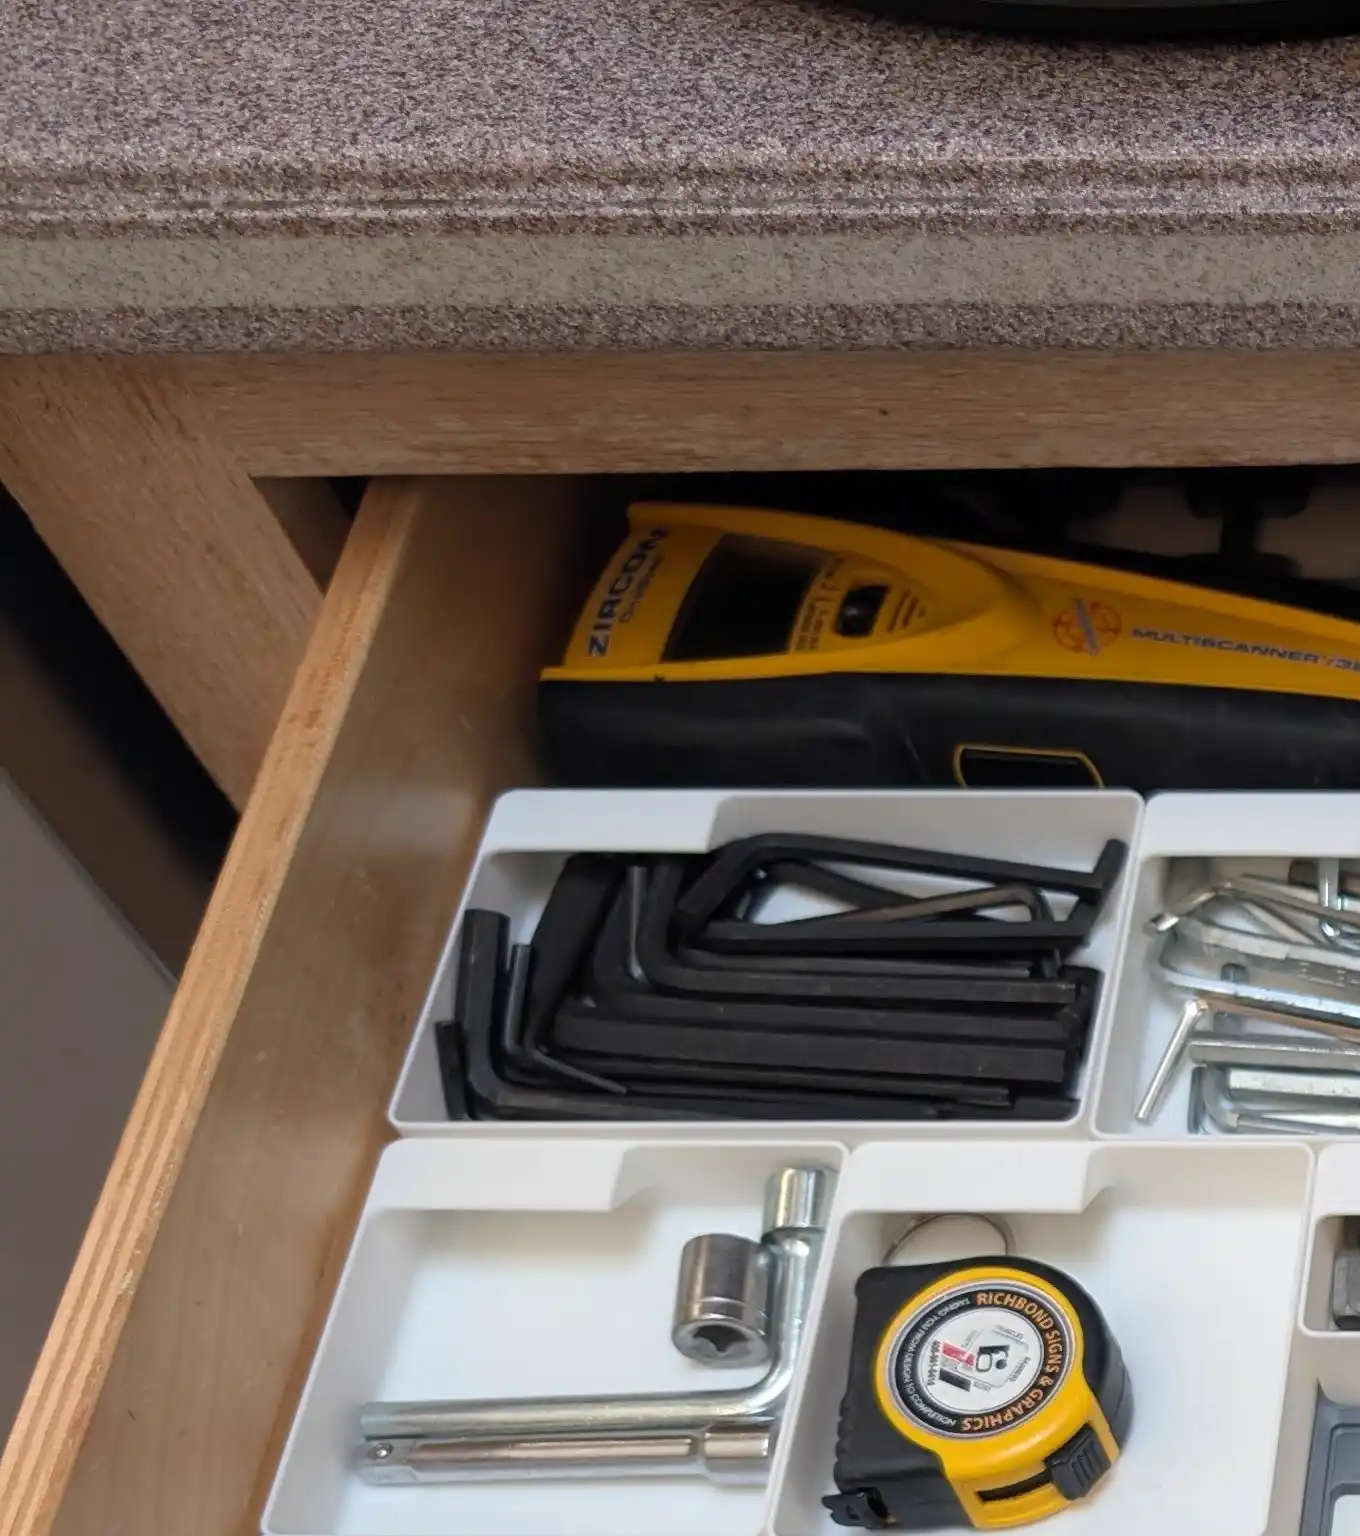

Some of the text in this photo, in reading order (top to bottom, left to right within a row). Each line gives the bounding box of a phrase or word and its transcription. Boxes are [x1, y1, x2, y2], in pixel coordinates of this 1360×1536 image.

[585, 528, 668, 658] ZIRCON
[1131, 627, 1319, 665] MULTISCANNER
[976, 1292, 1054, 1331] RICHBOND
[1045, 1330, 1063, 1373] SIGNS
[1038, 1375, 1054, 1386] &
[962, 1388, 1044, 1431] GRAPHICS
